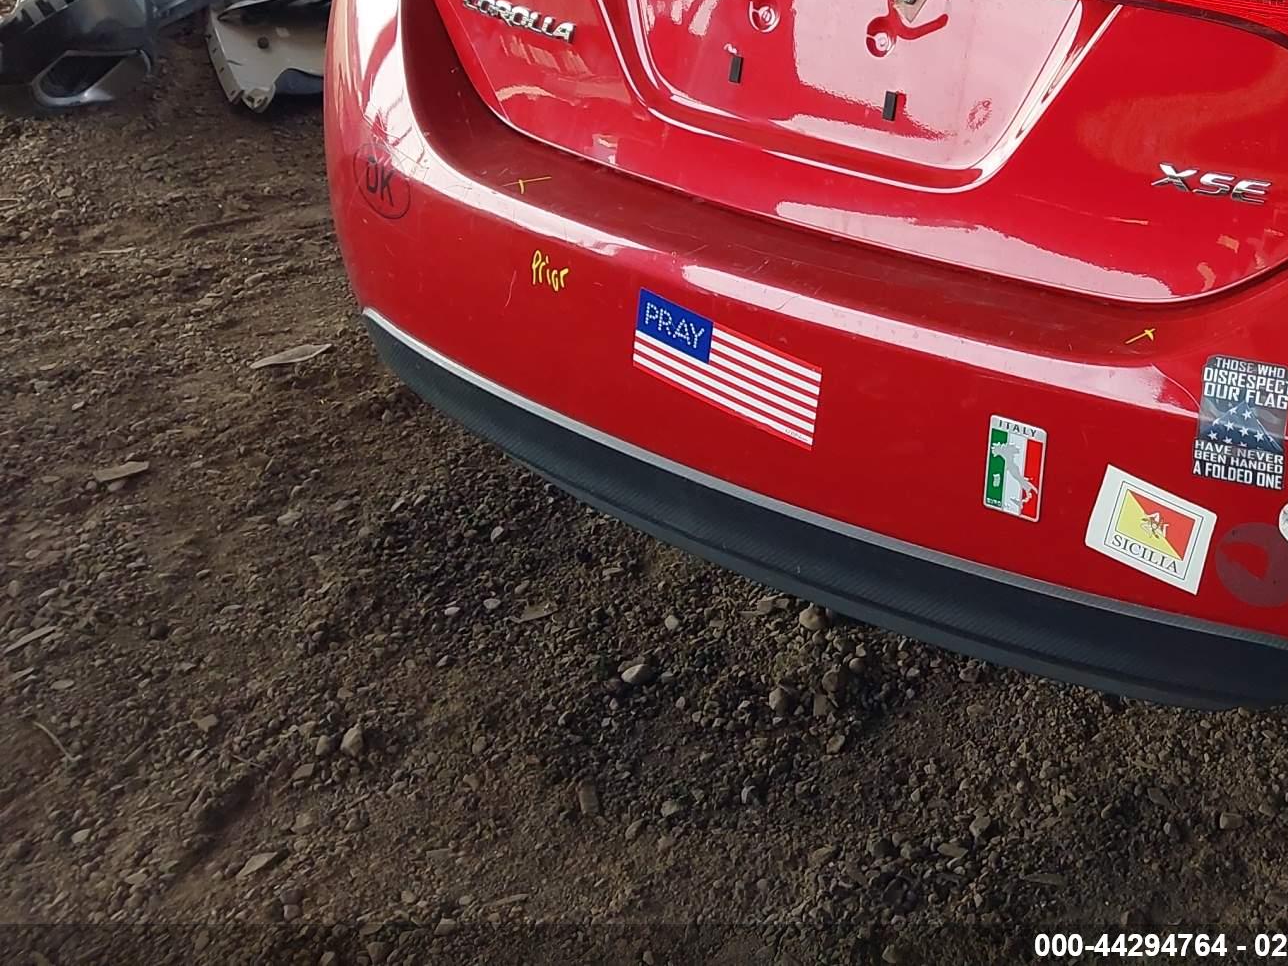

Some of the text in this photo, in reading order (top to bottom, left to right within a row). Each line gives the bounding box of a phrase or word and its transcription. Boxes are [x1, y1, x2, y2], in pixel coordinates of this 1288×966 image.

[1150, 162, 1272, 204] XSE
[531, 249, 569, 292] Prior
[644, 301, 705, 350] PRAY
[1215, 357, 1286, 379] THOSE WHO
[1203, 382, 1288, 410] OUR FLAG
[999, 419, 1037, 438] ITALY
[1194, 439, 1284, 465] HAVE NEVER
[1194, 450, 1283, 474] BEEN HANDED
[1192, 460, 1283, 490] A FOLDED ONE
[1111, 533, 1179, 574] SICILIA
